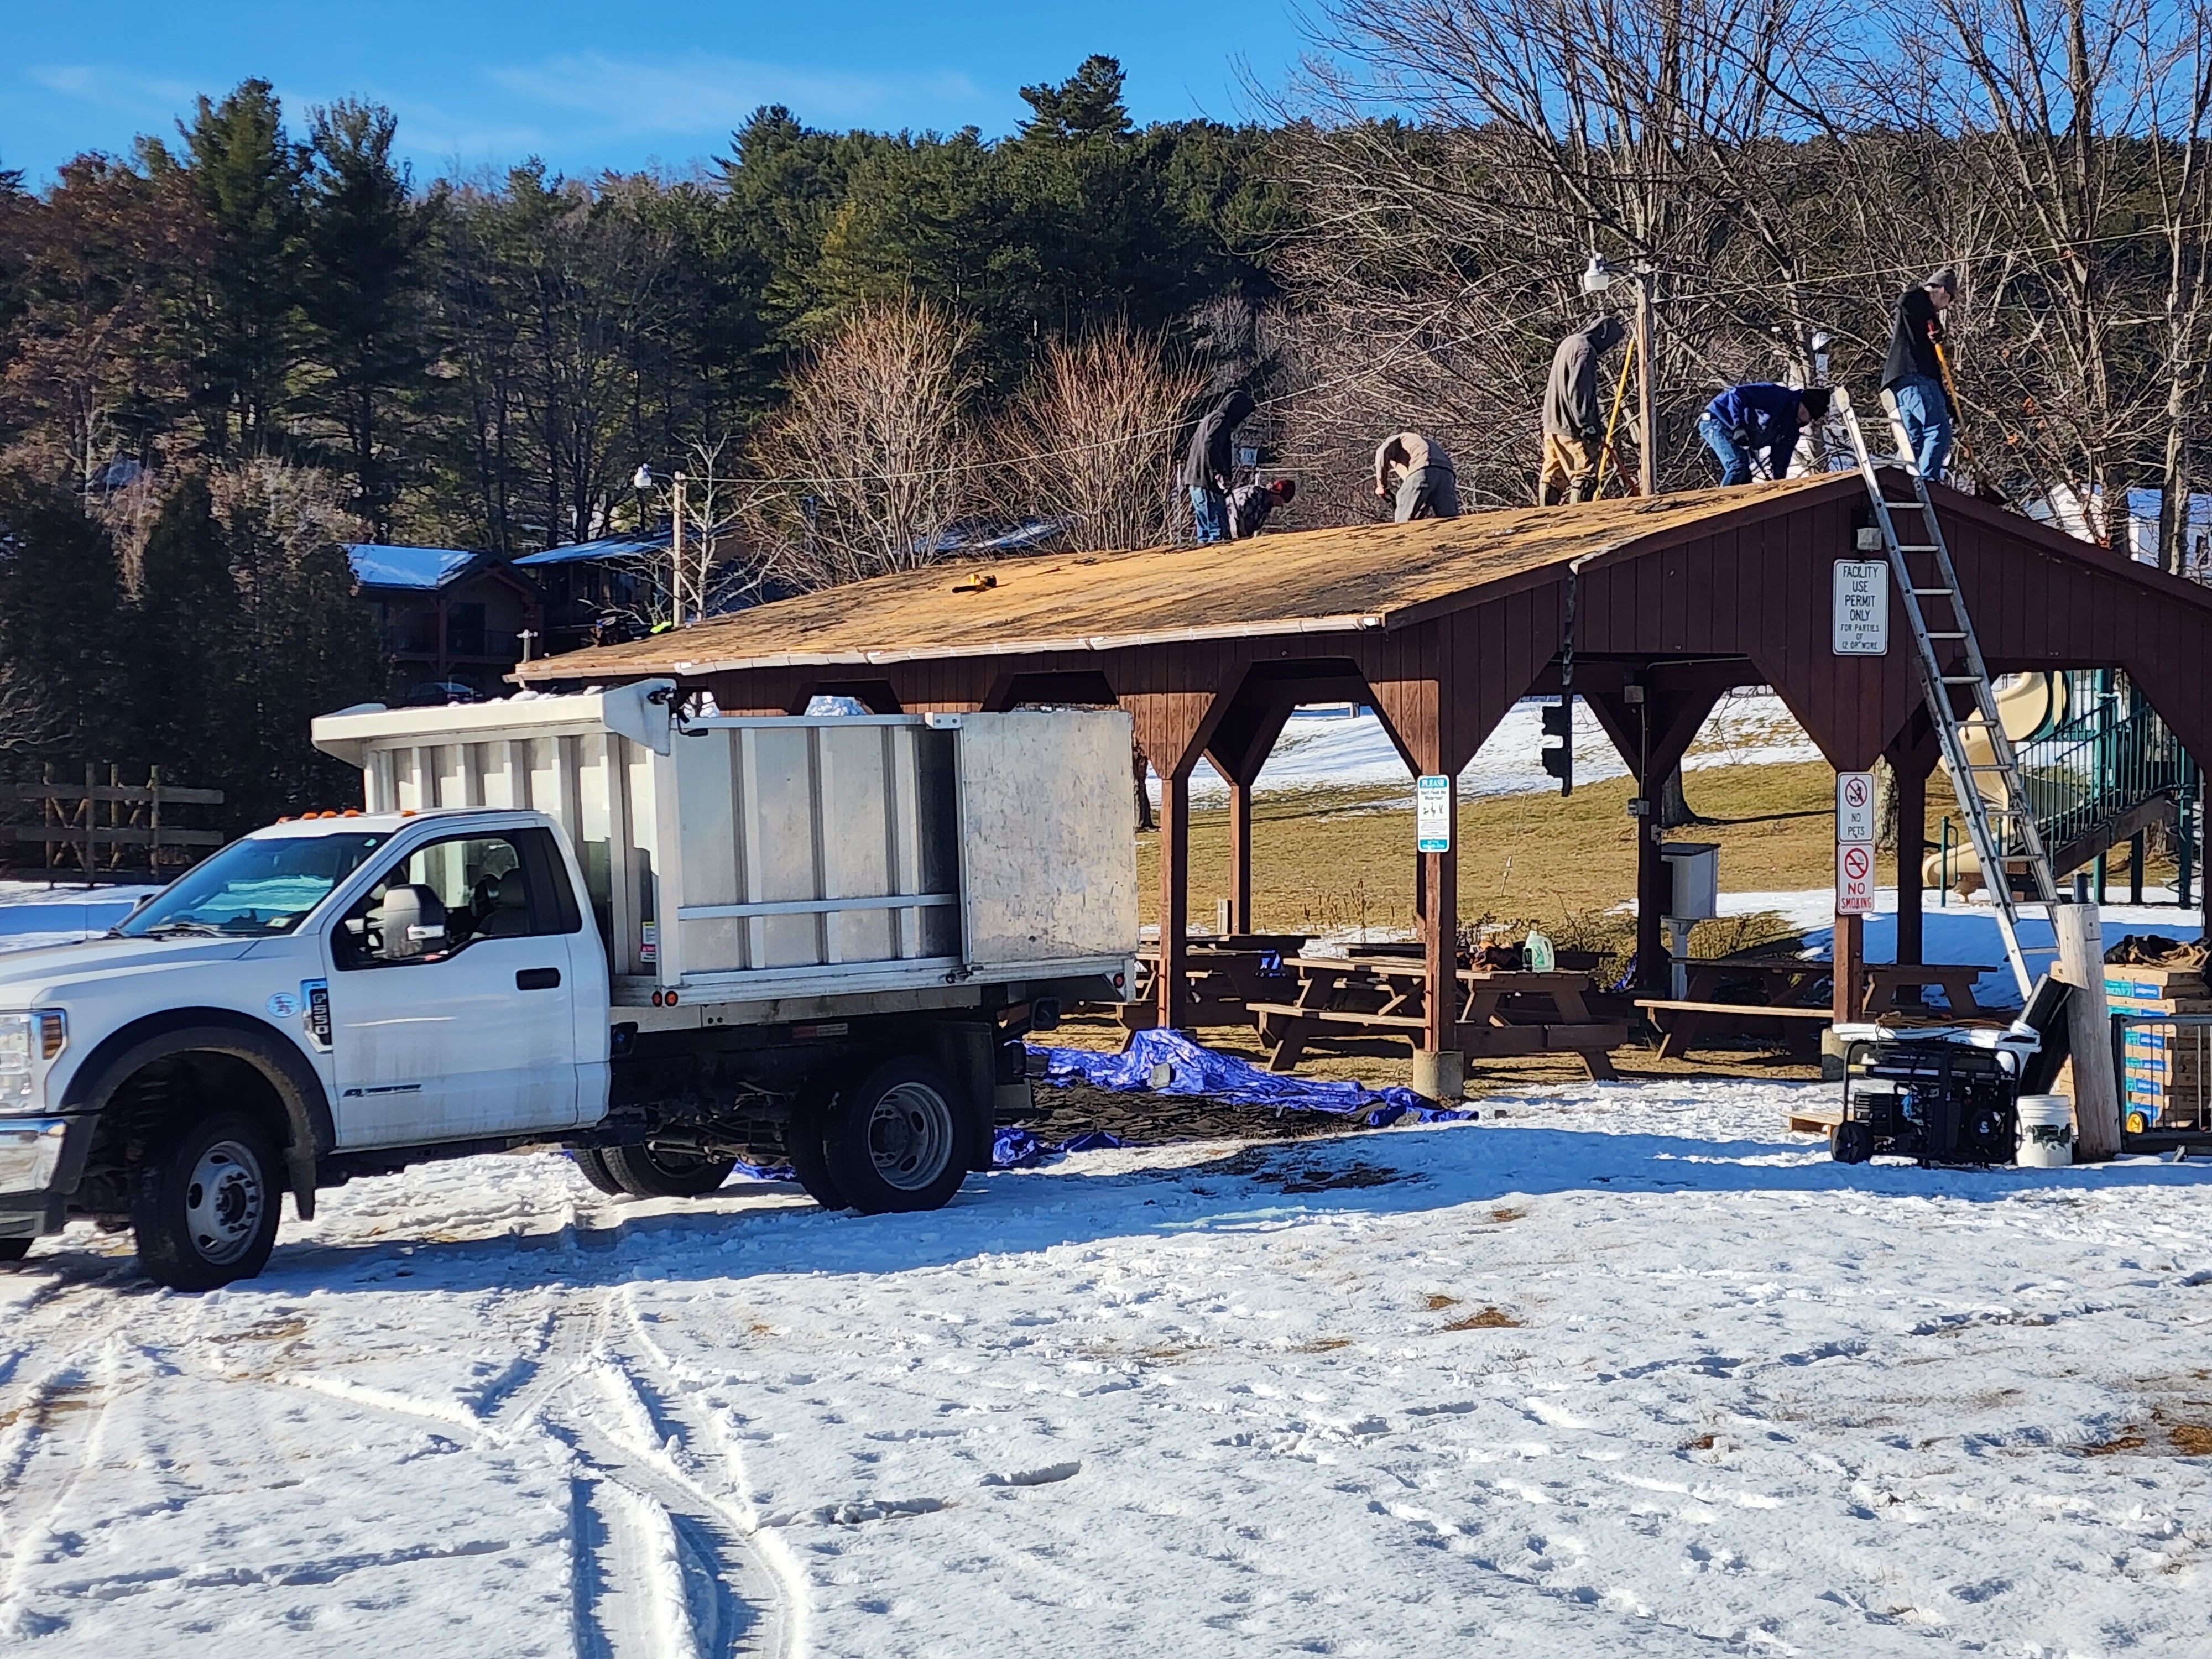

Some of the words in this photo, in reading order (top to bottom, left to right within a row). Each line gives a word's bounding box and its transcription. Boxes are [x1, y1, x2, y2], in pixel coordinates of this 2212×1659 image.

[1843, 566, 1879, 578] FACILITY
[1851, 580, 1869, 593] USE
[1844, 594, 1876, 607] PERMIT
[1849, 609, 1871, 622] ONLY
[1840, 623, 1852, 632] FOR
[1854, 623, 1880, 632] PARTIES
[1851, 812, 1861, 822] NO
[1848, 826, 1865, 837] PETS
[1847, 881, 1865, 895] NO
[1841, 896, 1872, 910] SMOKING
